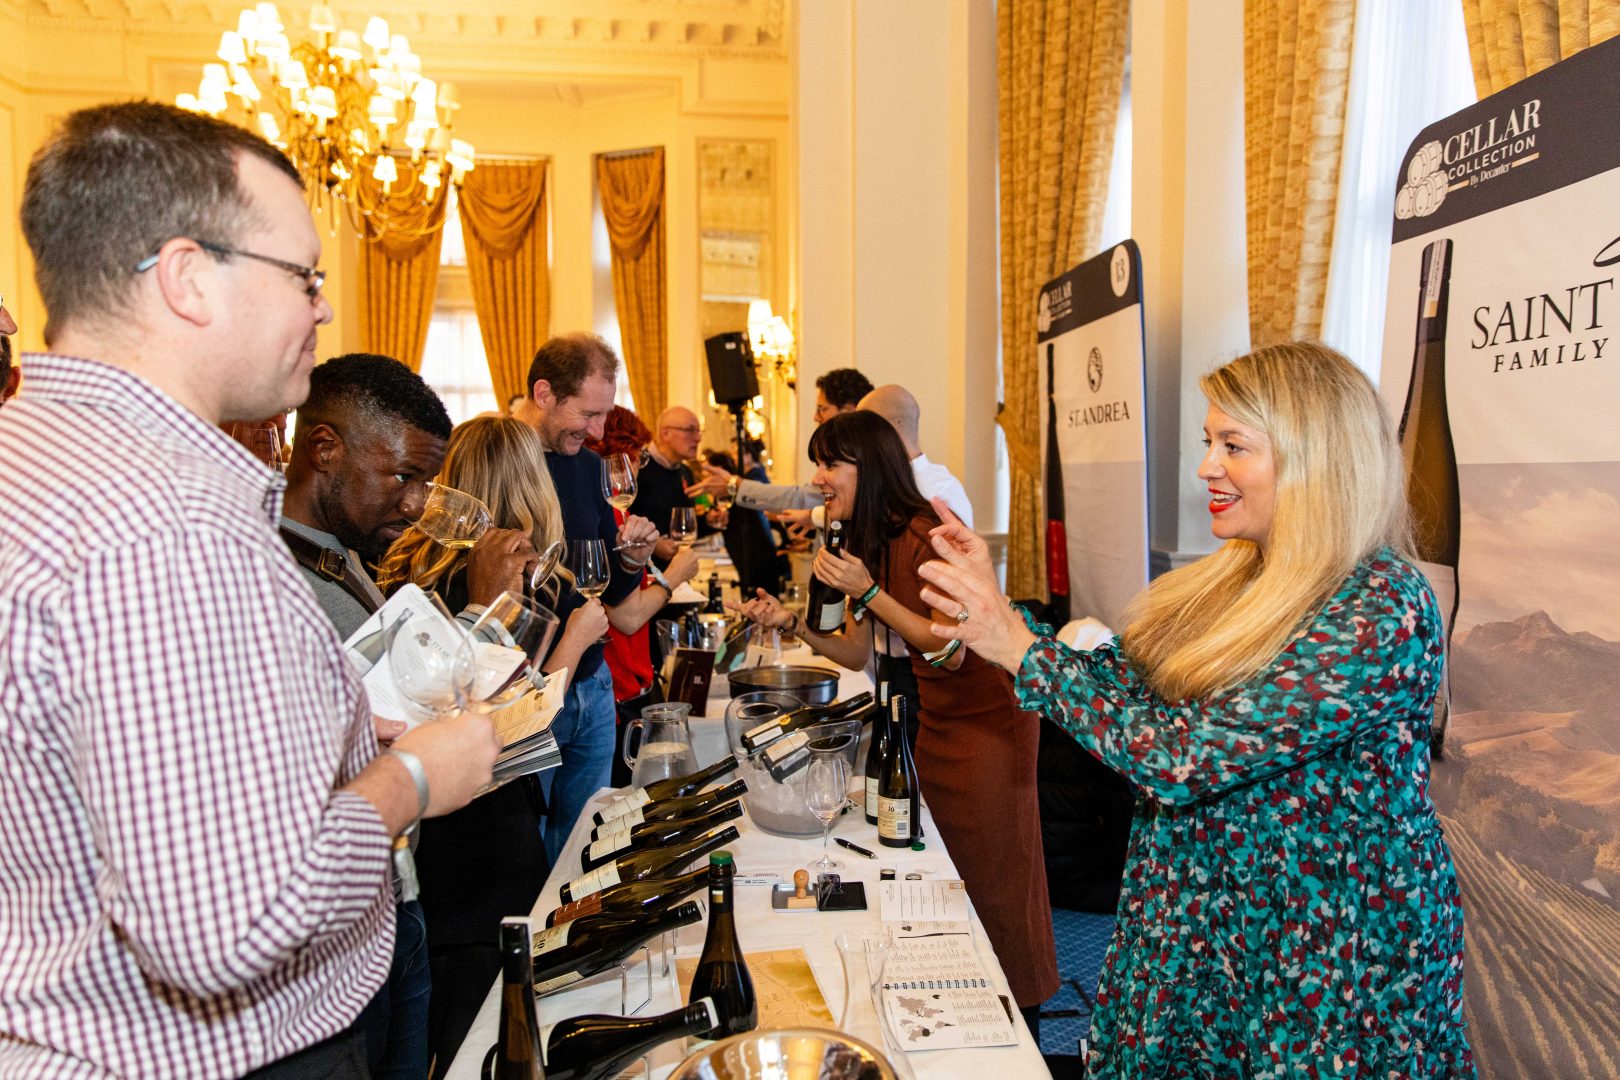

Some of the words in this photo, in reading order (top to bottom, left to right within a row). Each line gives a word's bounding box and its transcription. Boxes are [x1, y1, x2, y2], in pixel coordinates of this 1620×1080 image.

[1443, 99, 1541, 165] CELLAR
[1448, 134, 1536, 180] COLLECTION
[1470, 174, 1479, 188] By
[1480, 161, 1512, 182] Decanter
[1115, 258, 1126, 283] 13
[1471, 277, 1614, 350] SAINT
[1493, 337, 1609, 373] FAMILY
